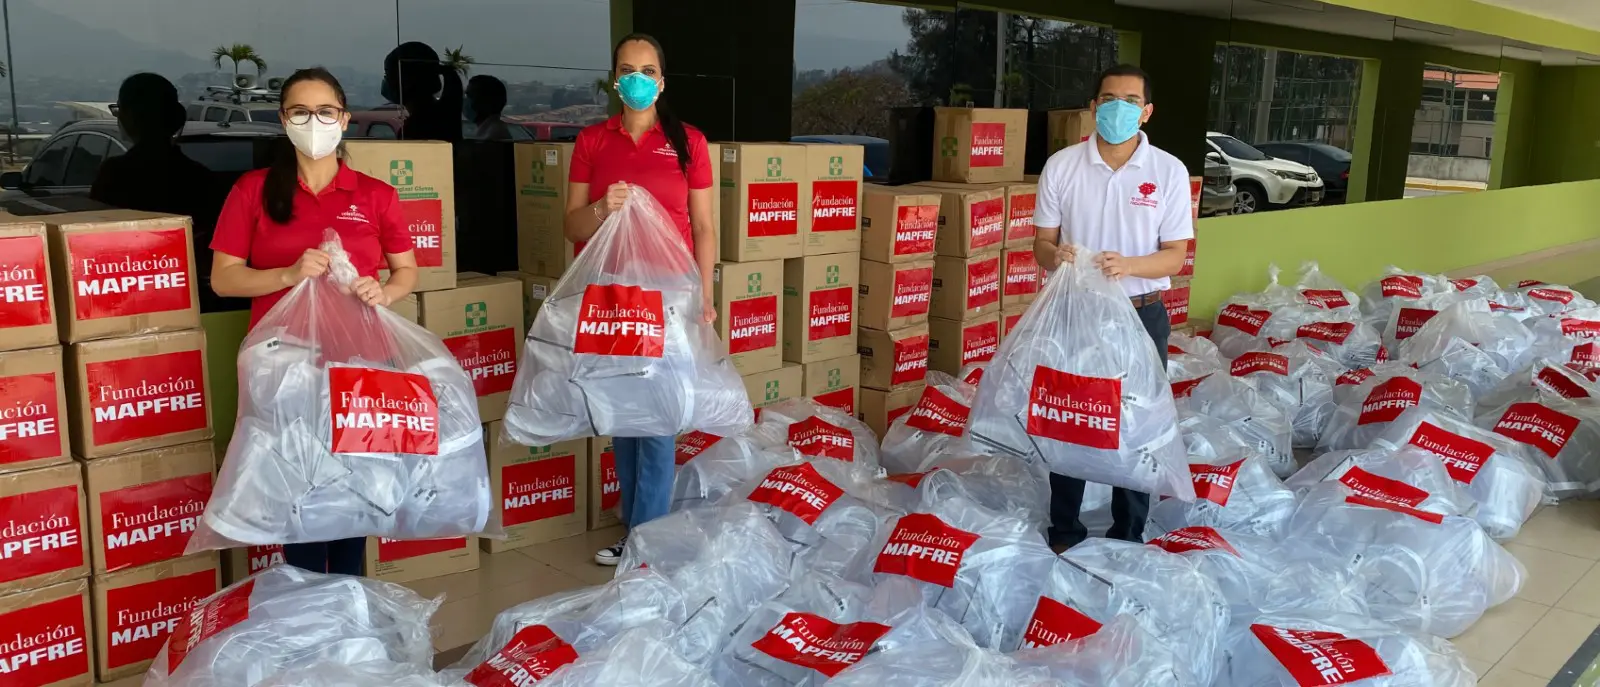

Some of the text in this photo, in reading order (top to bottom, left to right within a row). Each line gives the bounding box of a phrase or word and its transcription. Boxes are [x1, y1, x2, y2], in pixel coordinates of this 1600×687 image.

[972, 146, 1003, 156] MAPFRE
[752, 198, 794, 210] Fundación
[816, 195, 854, 206] Fundación
[750, 210, 796, 223] MAPFRE
[813, 207, 855, 218] MAPFRE
[900, 218, 933, 230] Fundación
[972, 222, 1003, 237] MAPFRE
[896, 230, 934, 241] MAPFRE
[83, 255, 179, 276] Fundación
[78, 272, 186, 296] MAPFRE
[897, 281, 929, 294] Fundación
[1007, 273, 1037, 284] MAPFRE
[894, 292, 930, 306] MAPFRE
[969, 281, 999, 297] MAPFRE
[588, 303, 657, 321] Fundación
[813, 302, 849, 315] Fundación
[1222, 310, 1262, 327] MAPFRE
[579, 320, 662, 337] MAPFRE
[734, 312, 774, 327] Fundación
[810, 313, 850, 327] MAPFRE
[731, 323, 775, 340] MAPFRE
[964, 344, 997, 360] MAPFRE
[967, 336, 996, 348] Fundación
[895, 358, 928, 372] MAPFRE
[100, 377, 195, 402] Fundación
[95, 392, 202, 423] MAPFRE
[340, 391, 428, 413] Fundación
[921, 397, 967, 423] Fundación
[1038, 387, 1112, 414] Fundación
[335, 412, 435, 432] MAPFRE
[1031, 403, 1116, 431] MAPFRE
[1507, 411, 1566, 436] Fundación
[789, 434, 853, 448] MAPFRE
[1497, 420, 1565, 447] MAPFRE
[1416, 434, 1480, 462] Fundación
[1431, 452, 1480, 472] PFRE
[508, 474, 569, 495] Fundación
[760, 478, 827, 511] MAPFRE
[772, 470, 829, 500] Fundación
[504, 486, 573, 510] MAPFRE
[112, 499, 204, 529] Fundación
[0, 513, 70, 539] dación
[0, 529, 78, 559] PFRE
[894, 528, 960, 548] Fundación
[882, 542, 959, 566] MAPFRE
[112, 617, 182, 646] MAPF
[790, 616, 864, 650] Fundación
[771, 624, 861, 664] MAPFRE
[1273, 627, 1344, 684] MAPFRE
